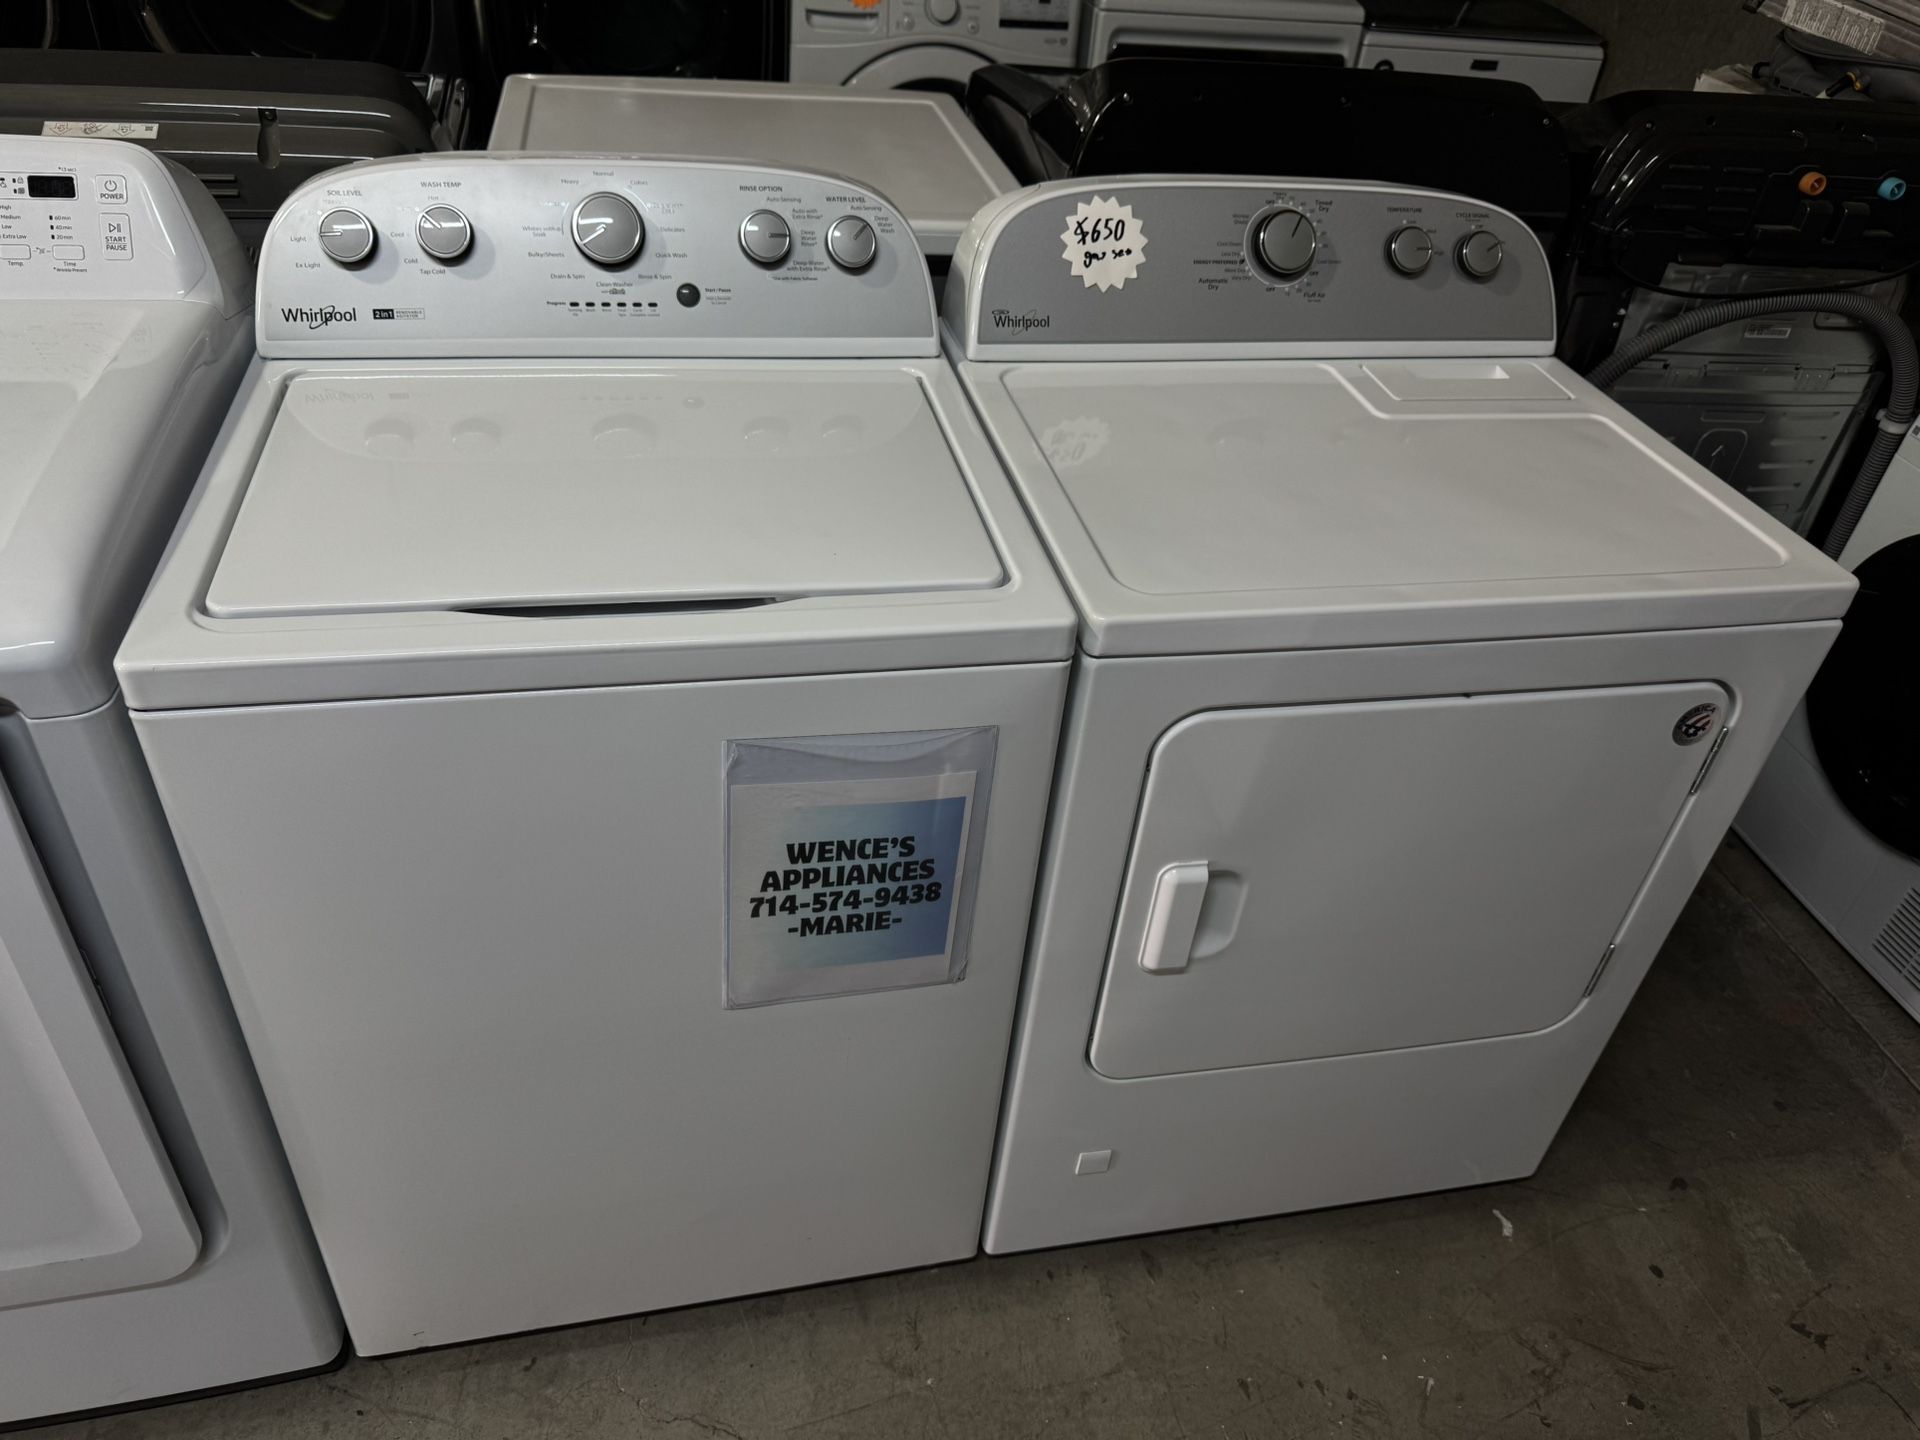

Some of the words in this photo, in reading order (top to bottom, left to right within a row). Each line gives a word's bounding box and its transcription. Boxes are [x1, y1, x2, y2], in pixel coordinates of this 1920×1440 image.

[343, 189, 363, 197] LEVEL
[280, 304, 358, 327] Whirlpool
[993, 313, 1050, 333] Whirlpool
[785, 835, 916, 865] WENCE'S
[760, 858, 936, 893] APPLIANCES
[749, 882, 943, 919] 714-574-9438
[787, 910, 903, 938] -MARIE-
